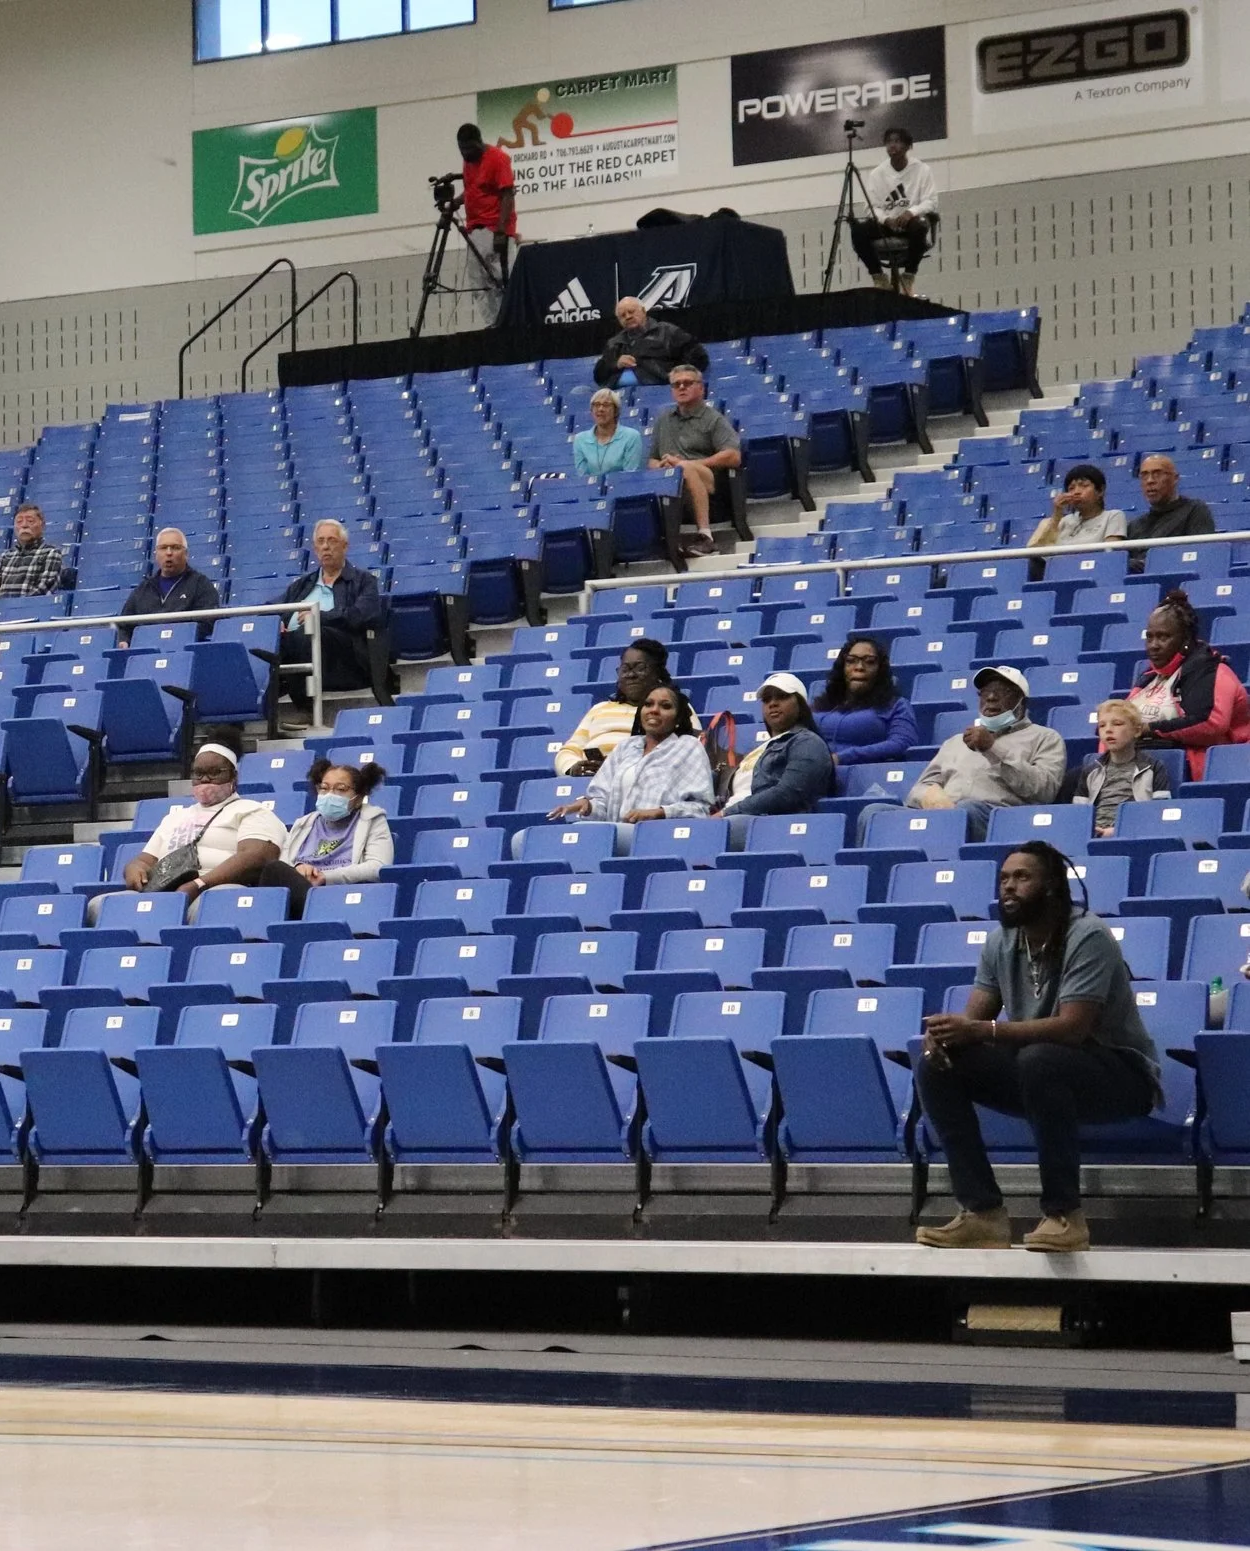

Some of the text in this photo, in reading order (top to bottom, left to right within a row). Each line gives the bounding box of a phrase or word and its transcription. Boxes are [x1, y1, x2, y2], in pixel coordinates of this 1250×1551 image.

[555, 70, 671, 98] CARPET MART
[1074, 77, 1191, 101] A Textron Company
[514, 152, 538, 163] ORCHARD
[539, 151, 548, 161] RD
[514, 149, 676, 181] ING OUT THE RED CARPET
[241, 140, 327, 212] Sprite
[514, 181, 539, 195] FOR
[543, 179, 567, 192] THE
[545, 308, 601, 324] adidas
